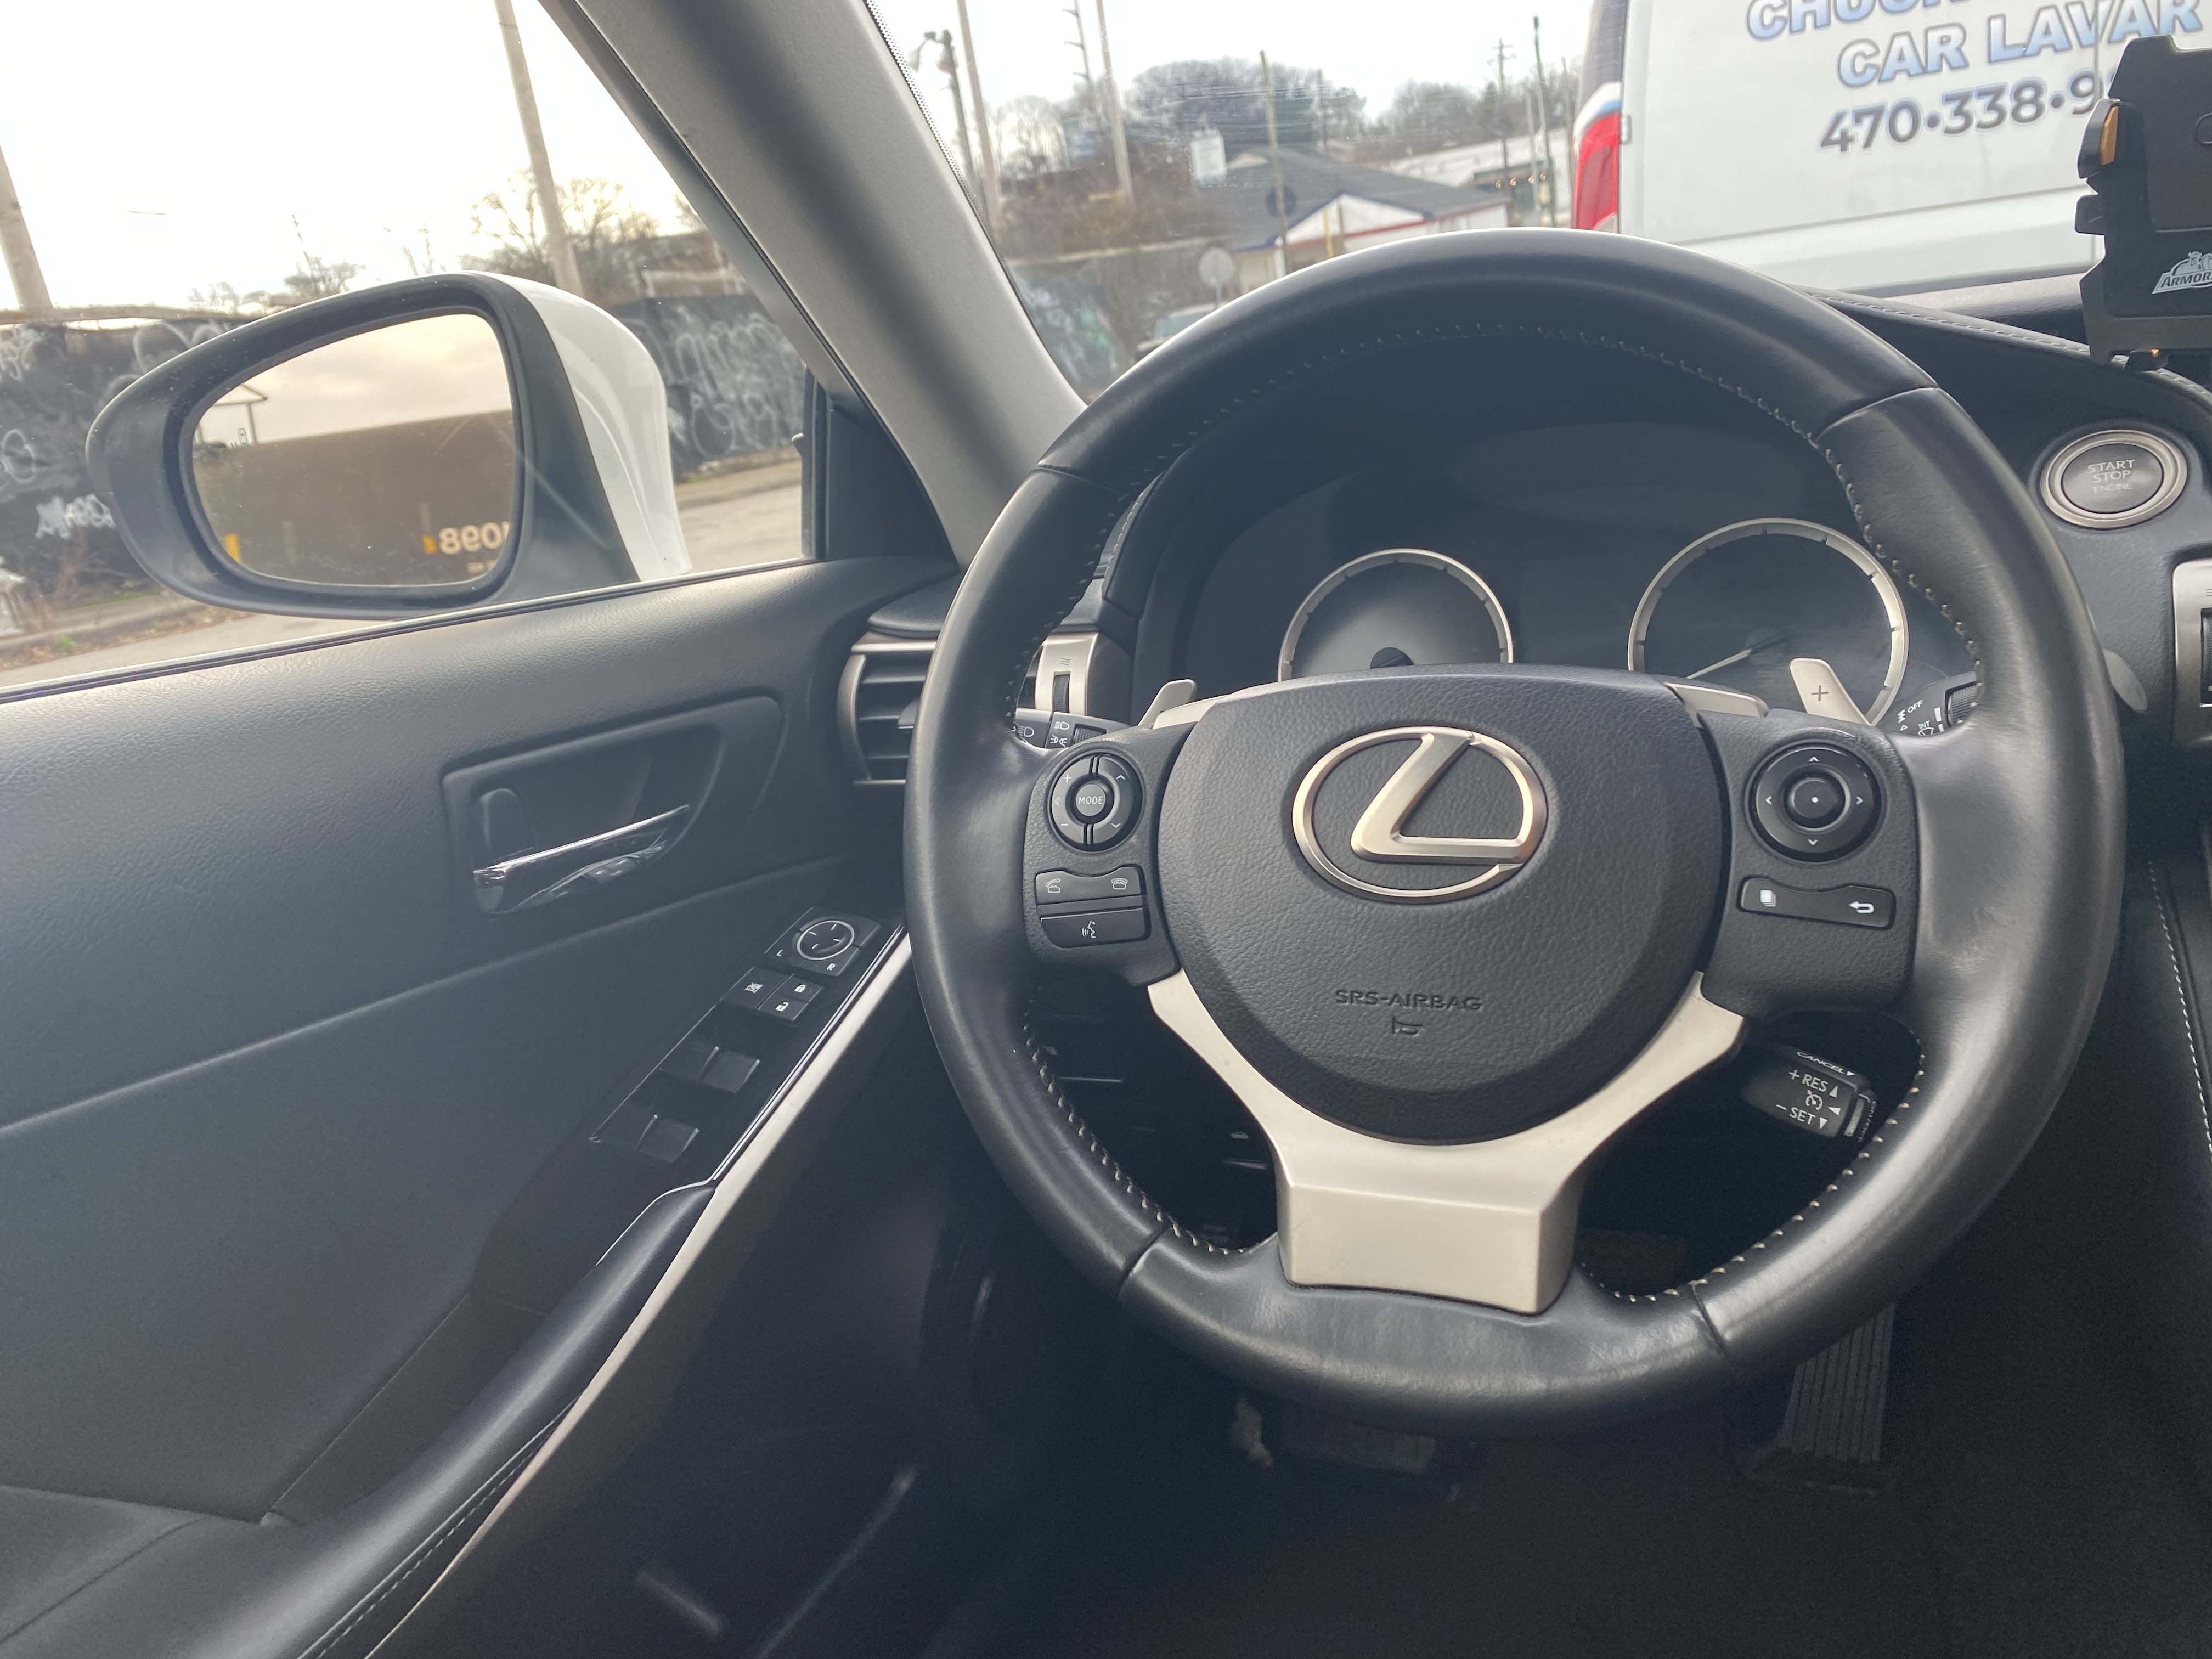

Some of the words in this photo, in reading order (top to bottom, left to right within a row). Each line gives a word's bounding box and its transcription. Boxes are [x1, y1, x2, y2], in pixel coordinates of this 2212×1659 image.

[1838, 22, 1970, 88] CAR
[2160, 271, 2212, 289] ARMOR
[2087, 459, 2135, 473] START
[2093, 470, 2131, 483] STOP
[1907, 699, 1923, 713] OFF
[1918, 720, 1931, 730] INT
[1078, 795, 1104, 805] MODE
[1335, 989, 1483, 1011] SRS-AIRBAG
[1797, 1052, 1844, 1074] CANCEL
[1802, 1074, 1829, 1092] RES
[1790, 1107, 1816, 1125] SET
